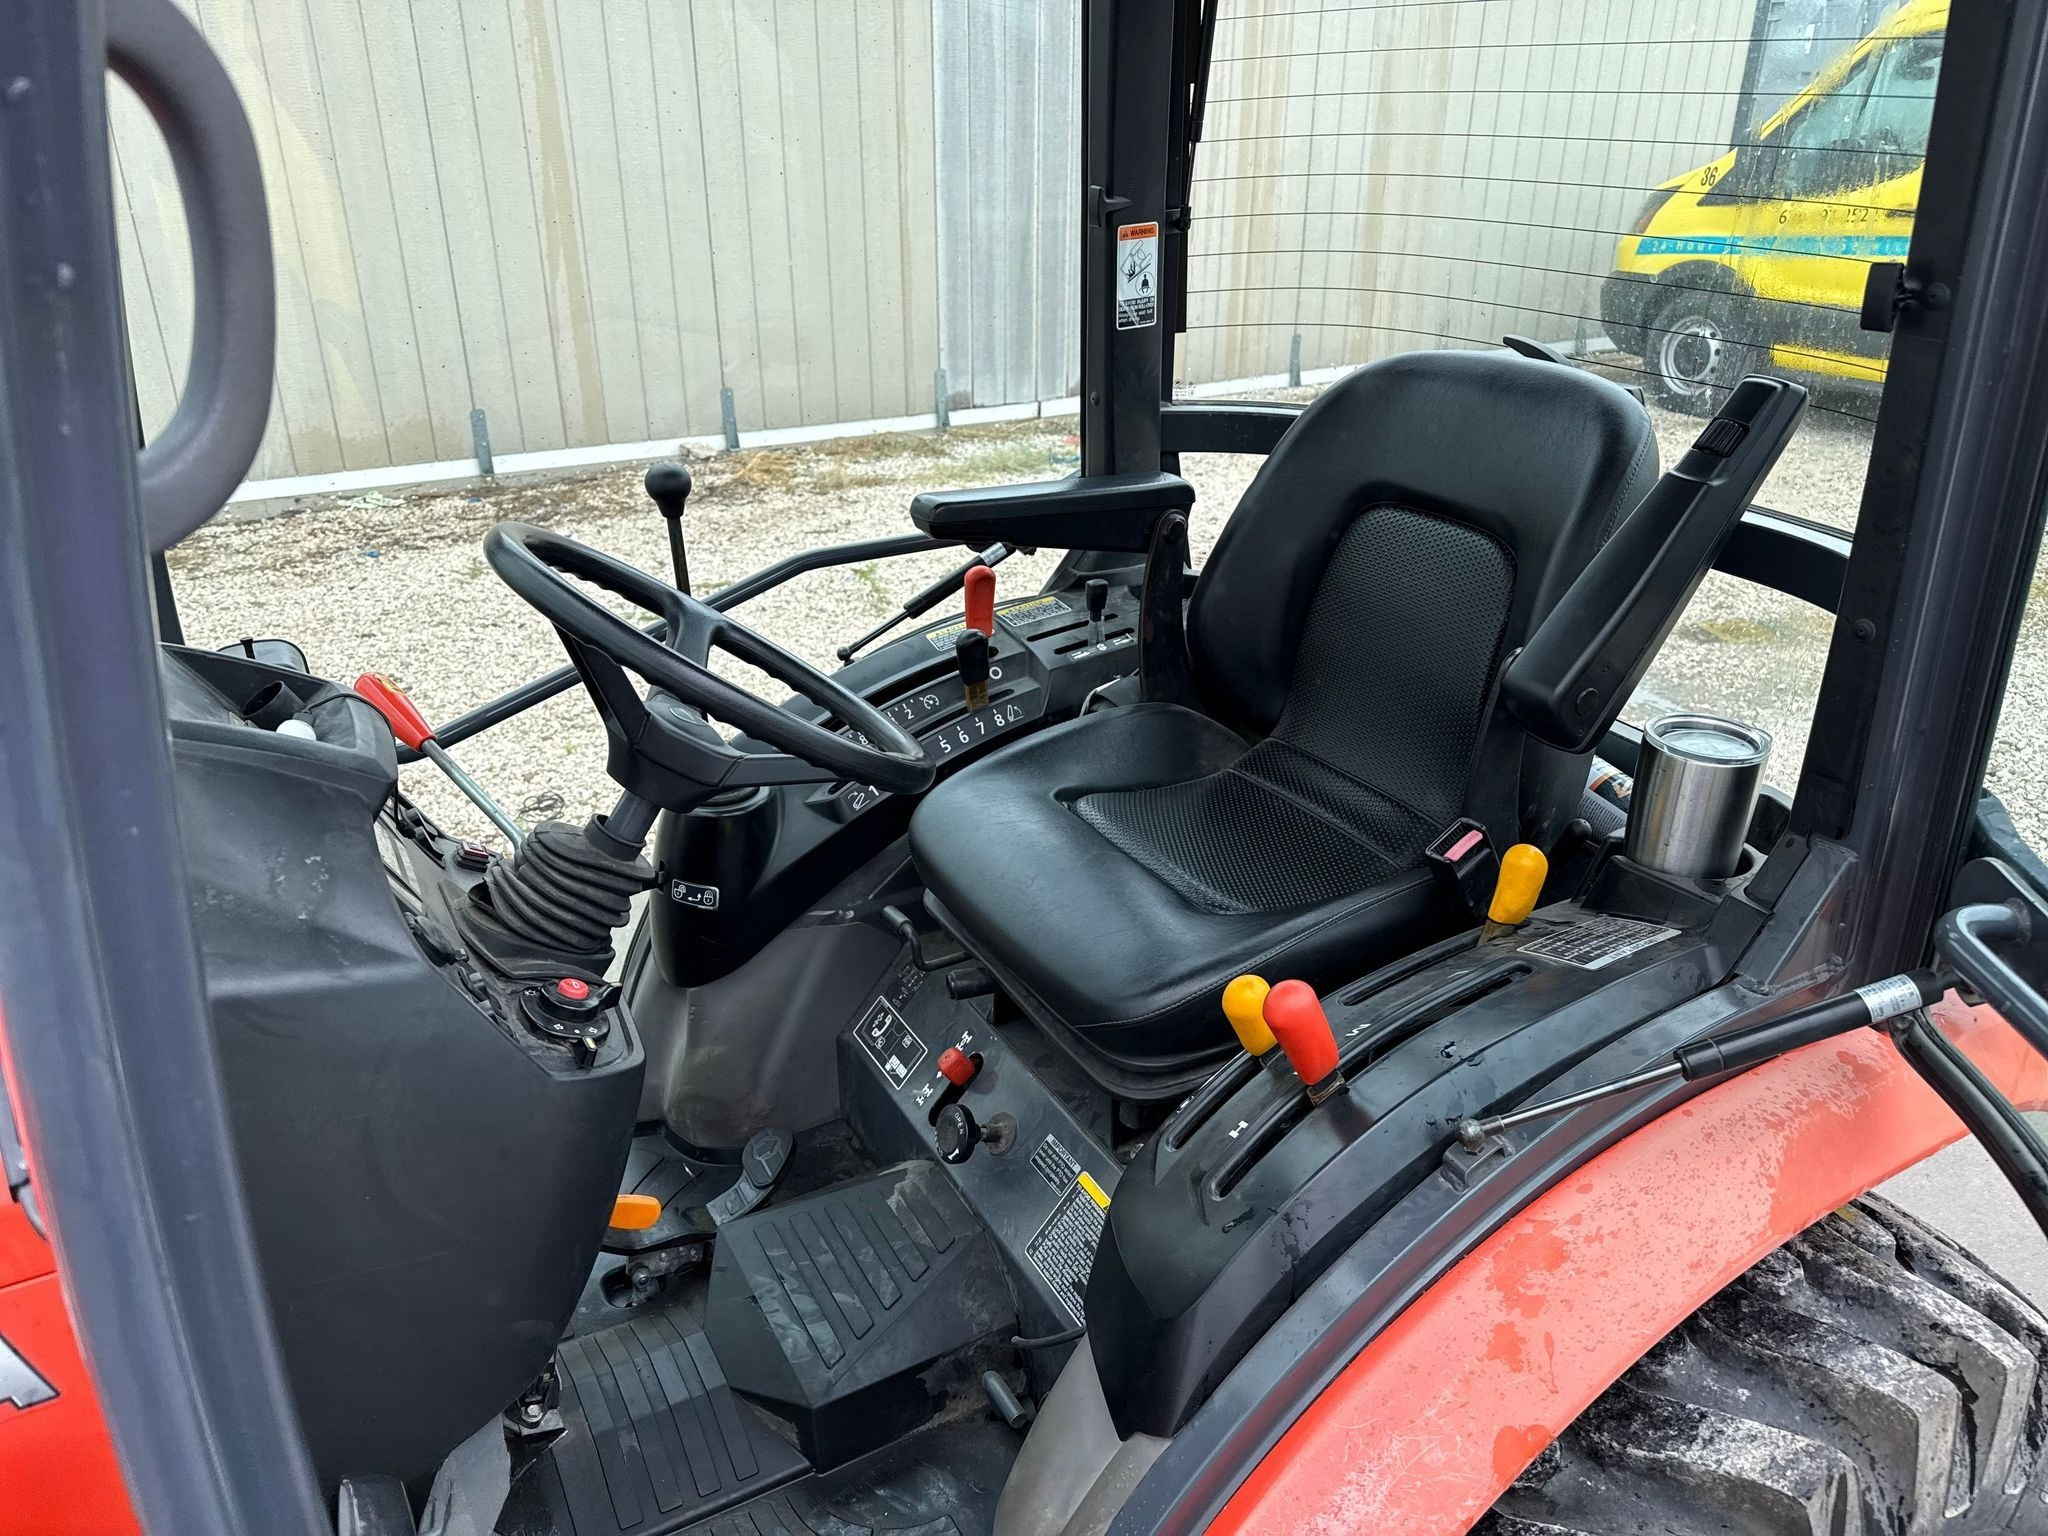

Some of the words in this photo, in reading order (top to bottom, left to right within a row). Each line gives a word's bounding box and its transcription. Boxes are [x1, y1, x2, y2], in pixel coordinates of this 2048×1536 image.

[1700, 166, 1718, 186] 36
[1130, 226, 1155, 237] WARNING
[904, 709, 915, 720] 2
[939, 739, 951, 754] 5
[958, 730, 969, 744] 6
[975, 721, 986, 735] 7
[993, 713, 1005, 727] 8
[954, 1112, 965, 1135] OPEN
[1050, 1139, 1076, 1167] IMPORTANT
